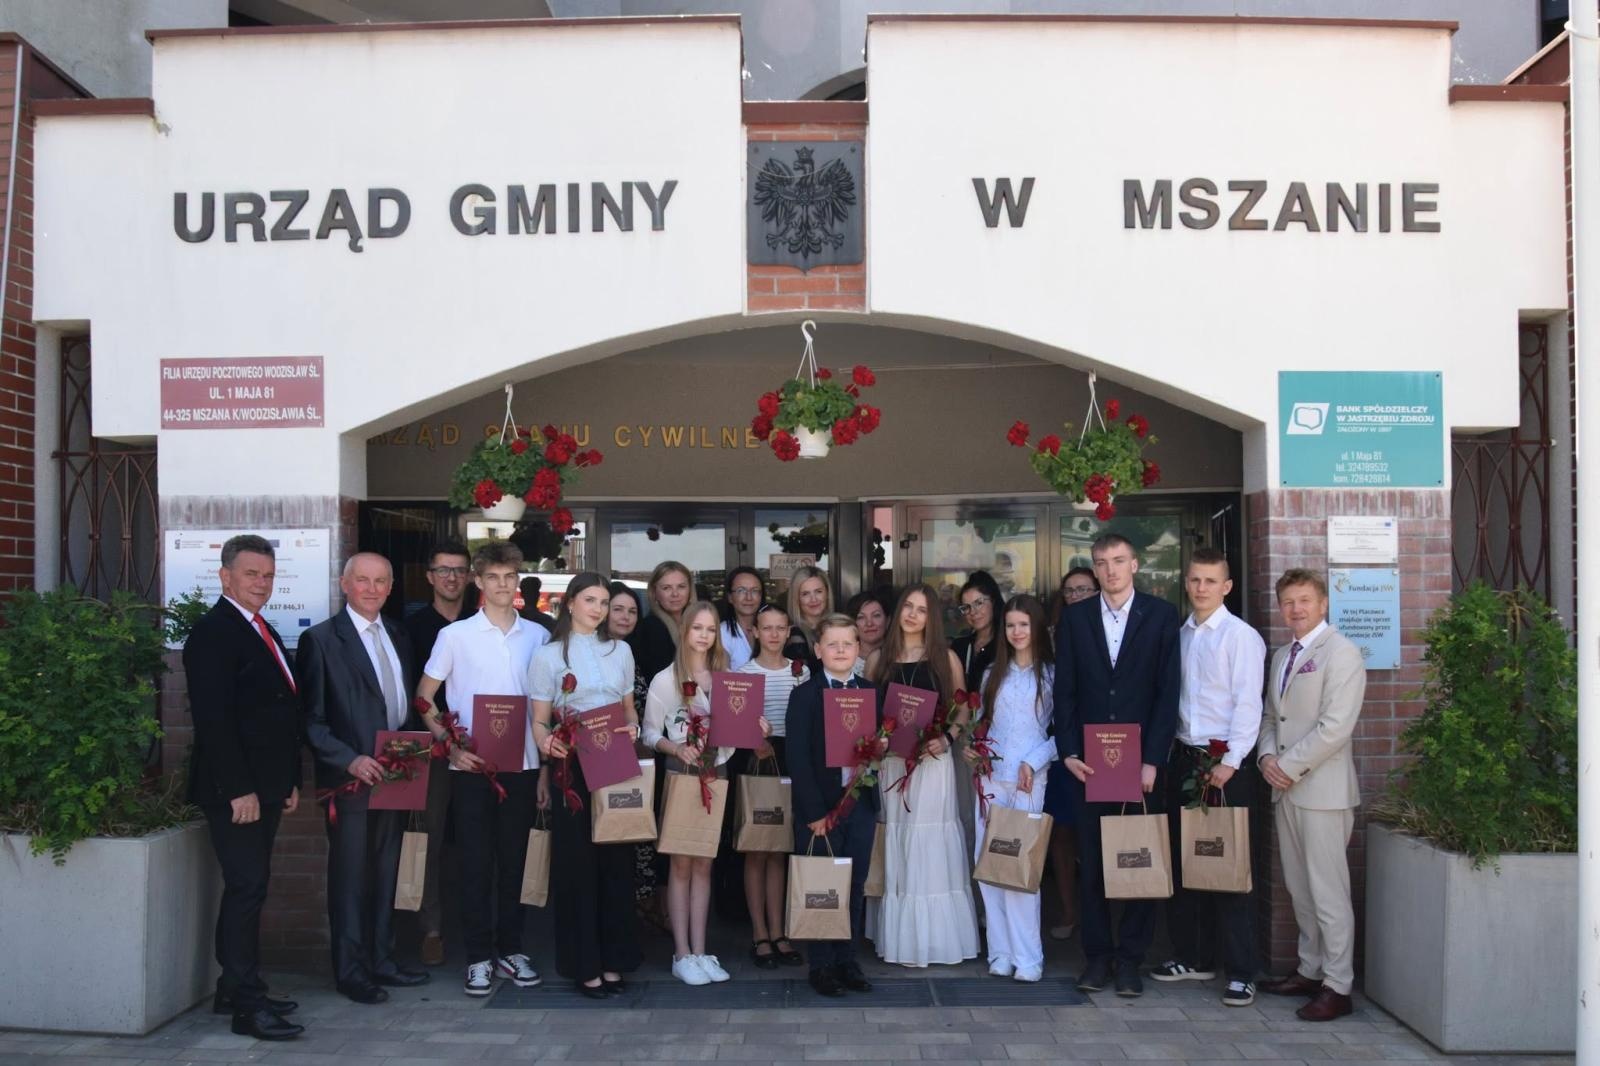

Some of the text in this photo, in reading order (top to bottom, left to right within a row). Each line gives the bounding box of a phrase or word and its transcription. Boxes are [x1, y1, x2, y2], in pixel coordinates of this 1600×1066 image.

[173, 176, 1441, 253] URZĄD GMINY W MSZANIE
[163, 366, 181, 379] FILIA
[182, 366, 212, 381] URZĘDU
[212, 366, 263, 379] POCZTOWEGO
[264, 365, 308, 378] WODZISŁAW
[209, 386, 275, 399] UL. 1 MAJA 81
[163, 409, 191, 421] 44-325
[193, 408, 231, 421] MSZANA
[232, 407, 305, 421] K/WODZISŁAWIA
[1336, 403, 1428, 413] BANK SPÓŁDZIELCZY
[1400, 415, 1435, 423] ZDROJU
[614, 425, 780, 448] CYWILNE
